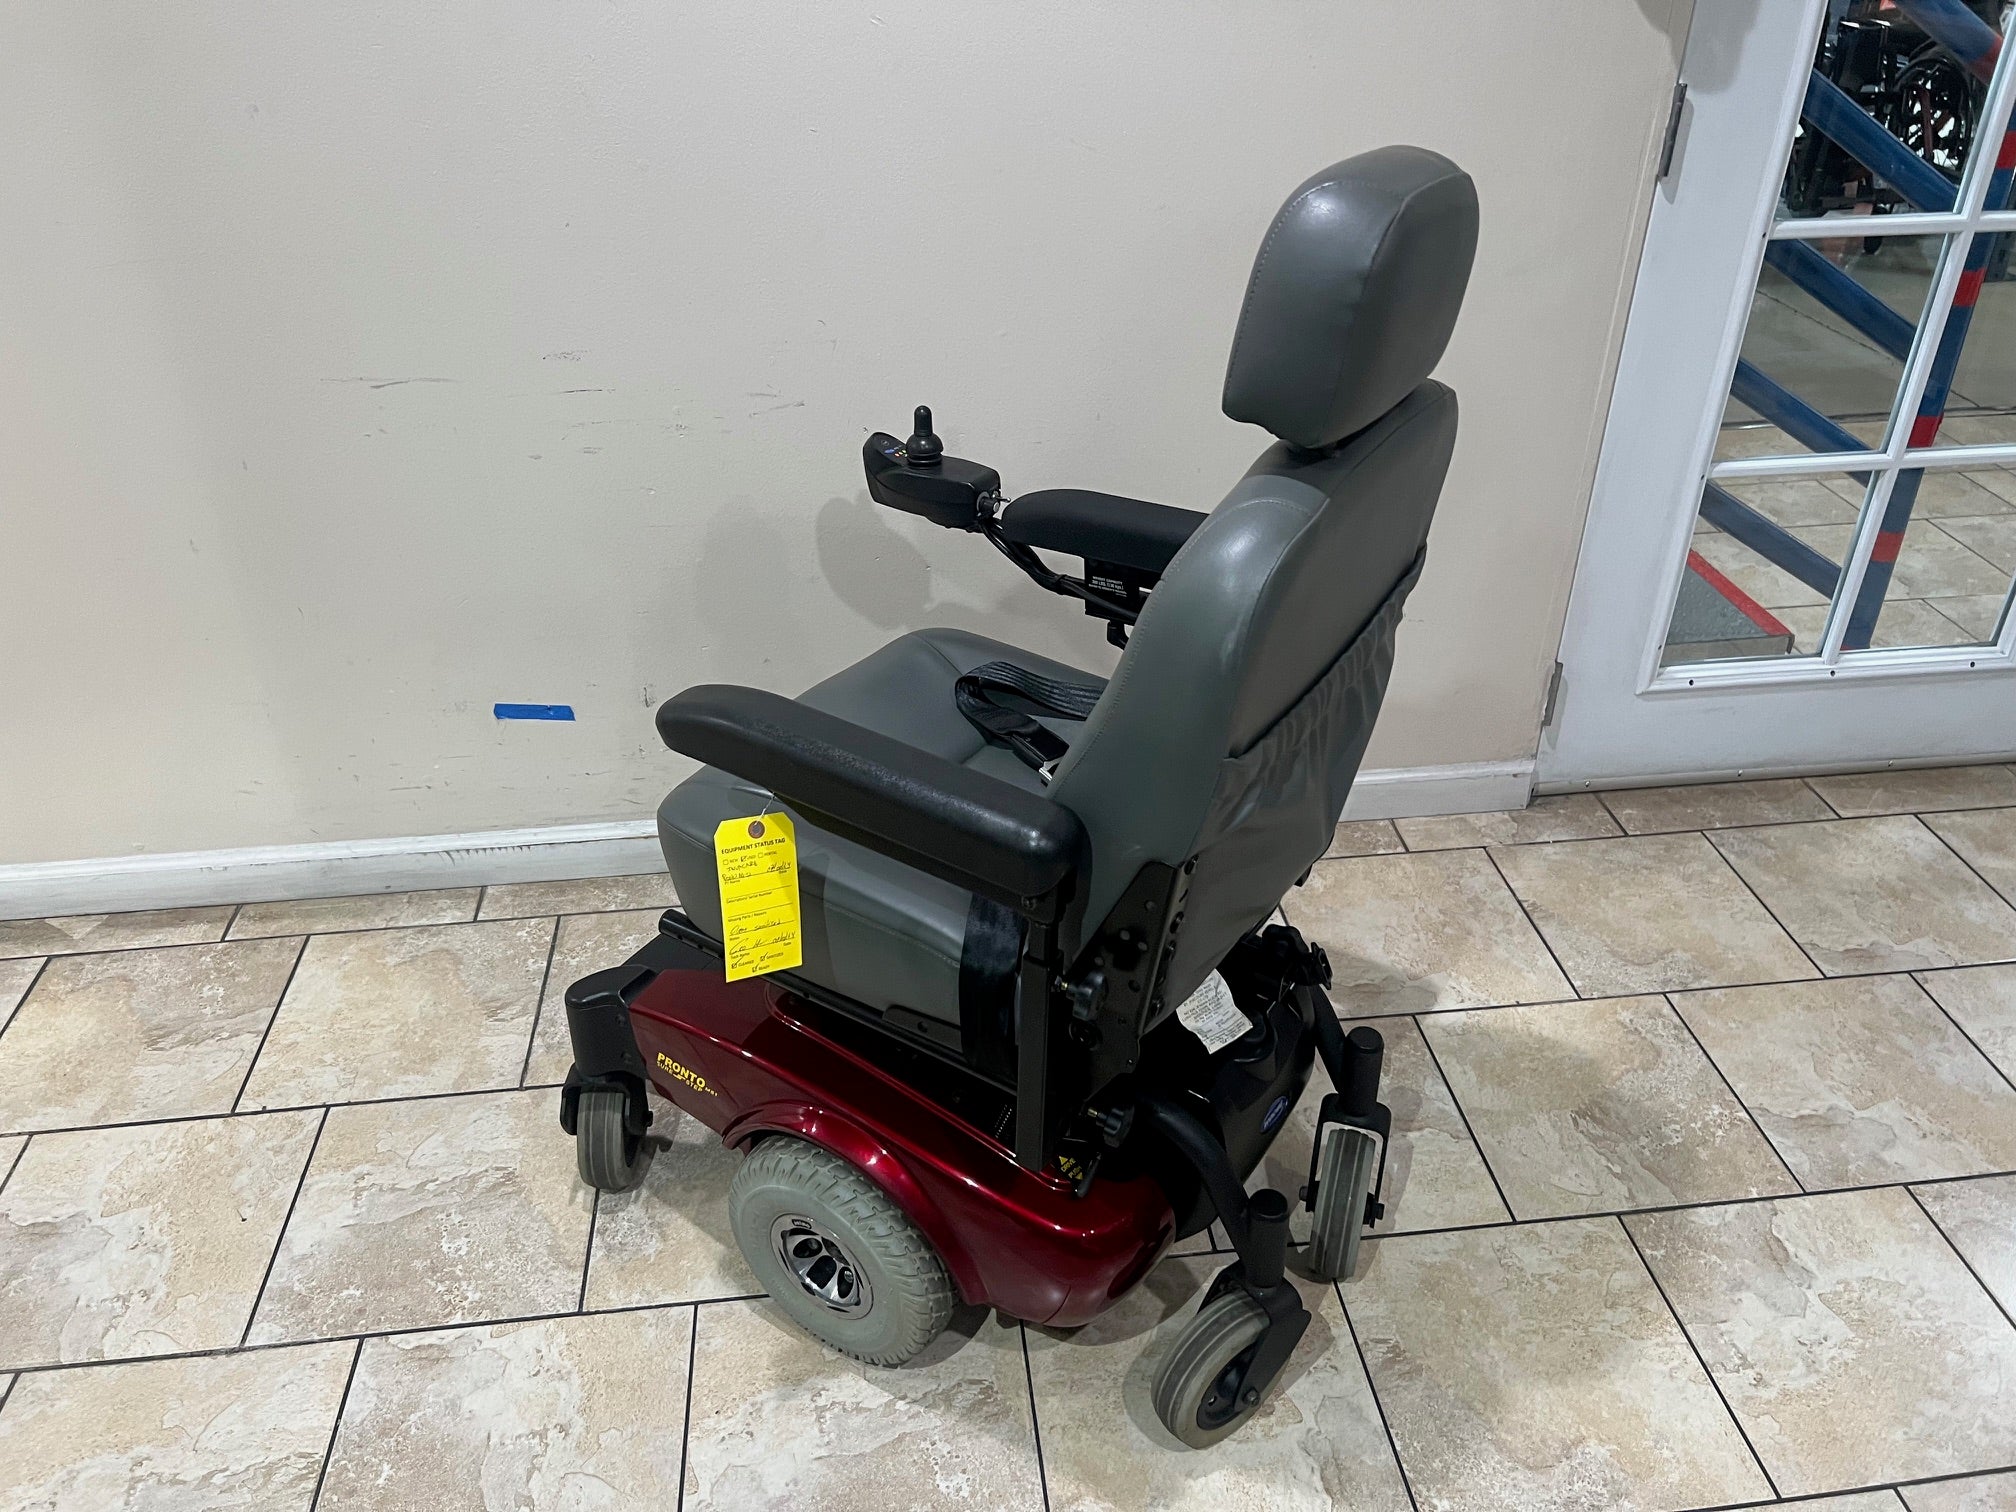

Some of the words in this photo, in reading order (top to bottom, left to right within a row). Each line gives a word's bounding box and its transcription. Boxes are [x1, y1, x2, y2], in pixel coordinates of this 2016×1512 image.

[722, 844, 753, 854] EQUIPMENT
[754, 840, 774, 848] STATUS
[657, 1052, 706, 1088] PRONTO
[685, 1080, 703, 1092] STEP
